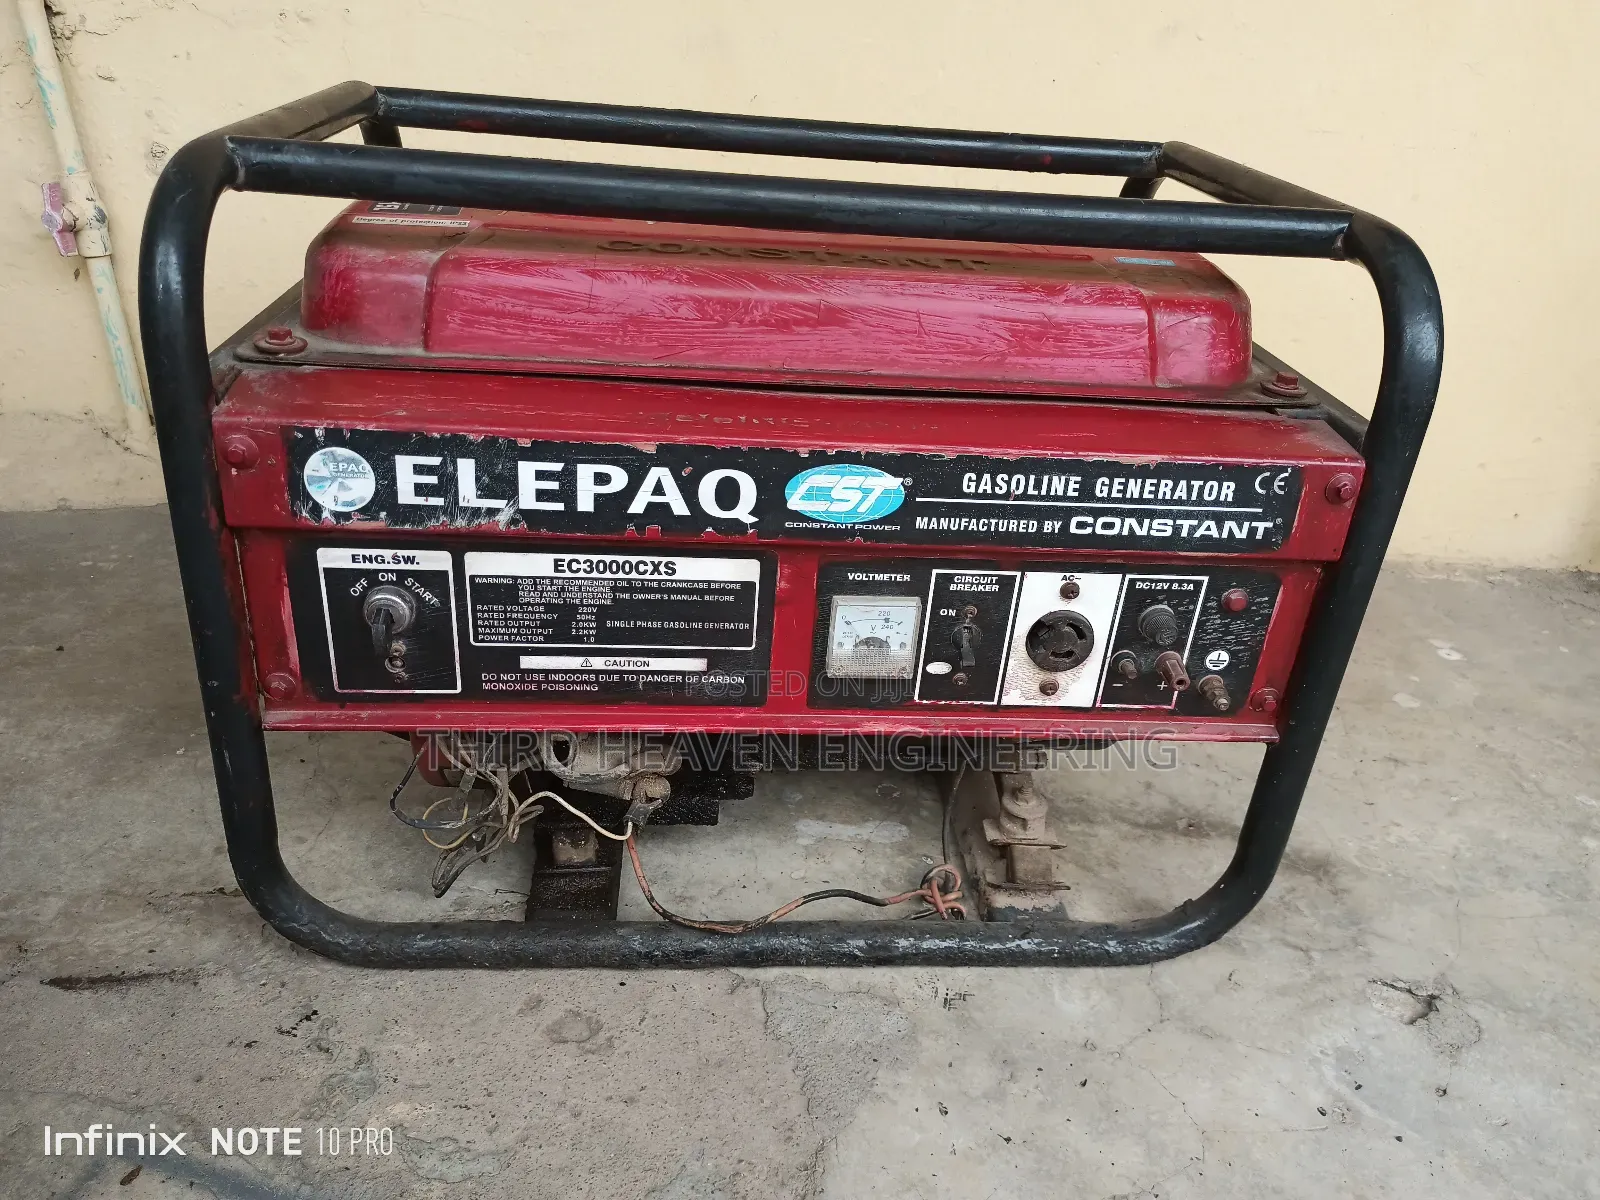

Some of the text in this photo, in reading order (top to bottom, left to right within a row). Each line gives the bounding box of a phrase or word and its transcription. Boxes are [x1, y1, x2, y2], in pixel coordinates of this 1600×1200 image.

[395, 454, 760, 523] ELEPAQ
[962, 472, 1236, 502] GASOLINE GENERATOR
[787, 474, 904, 513] CST
[785, 521, 853, 530] CONSTANT
[915, 516, 1274, 540] MANUFACTURED BY CONSTANT
[351, 552, 420, 565] ENG.SW.
[553, 558, 677, 577] EC3000CXS
[378, 572, 397, 582] ON
[847, 572, 911, 583] VOLTMETER
[953, 575, 998, 585] CIRCUIT
[350, 577, 368, 597] OFF
[537, 584, 562, 592] START
[660, 581, 708, 589] CRANKCASE
[710, 582, 742, 590] BEFORE
[949, 583, 1000, 593] BREAKER
[1135, 581, 1195, 591] DC12V 8.3A
[404, 577, 440, 608] START
[506, 612, 558, 620] FREQUENCY
[939, 608, 956, 617] ON
[606, 620, 750, 630] SINGLE PHASE GASOLINE GENERATOR
[604, 659, 650, 668] CAUTION
[481, 672, 745, 684] DO NOT USE INDOORS DUE TO DANGER OF CARBON
[482, 682, 599, 692] MONOXIDE POISONING
